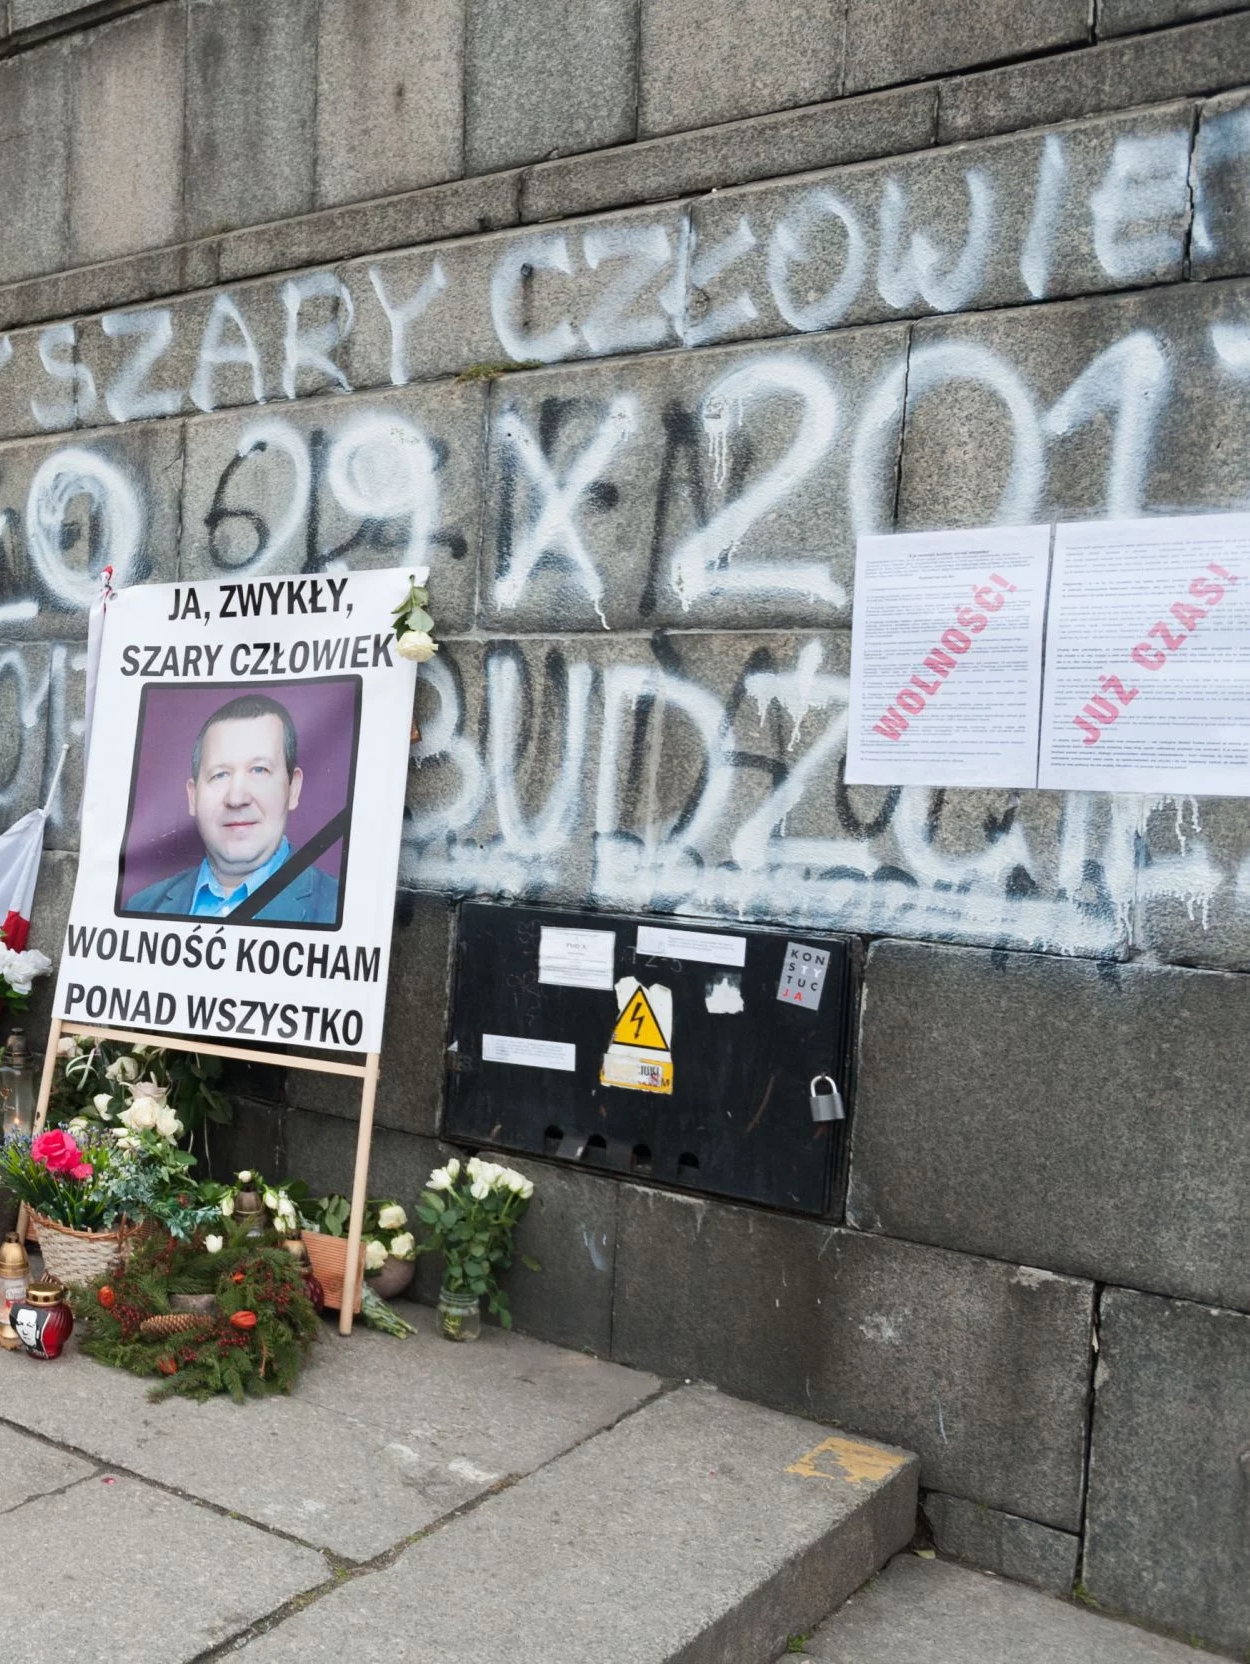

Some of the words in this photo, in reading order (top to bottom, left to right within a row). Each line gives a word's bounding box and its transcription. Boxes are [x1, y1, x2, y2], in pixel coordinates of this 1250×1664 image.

[32, 257, 448, 430] SZARY
[493, 392, 638, 612] X
[670, 322, 1250, 612] 201
[168, 588, 211, 626] JA,
[219, 578, 353, 619] ZWYKŁY,
[120, 643, 223, 677] SZARY
[229, 633, 395, 676] CZŁOWIEK
[872, 573, 1017, 741] WOLNOŚĆ!
[1072, 675, 1139, 745] JUŻ
[1130, 562, 1239, 671] CZAS!
[67, 924, 227, 970] WOLNOŚĆ
[235, 938, 381, 983] KOCHAM
[791, 949, 825, 966] KON
[64, 982, 177, 1026] PONAD
[187, 995, 363, 1046] WSZYSTKO
